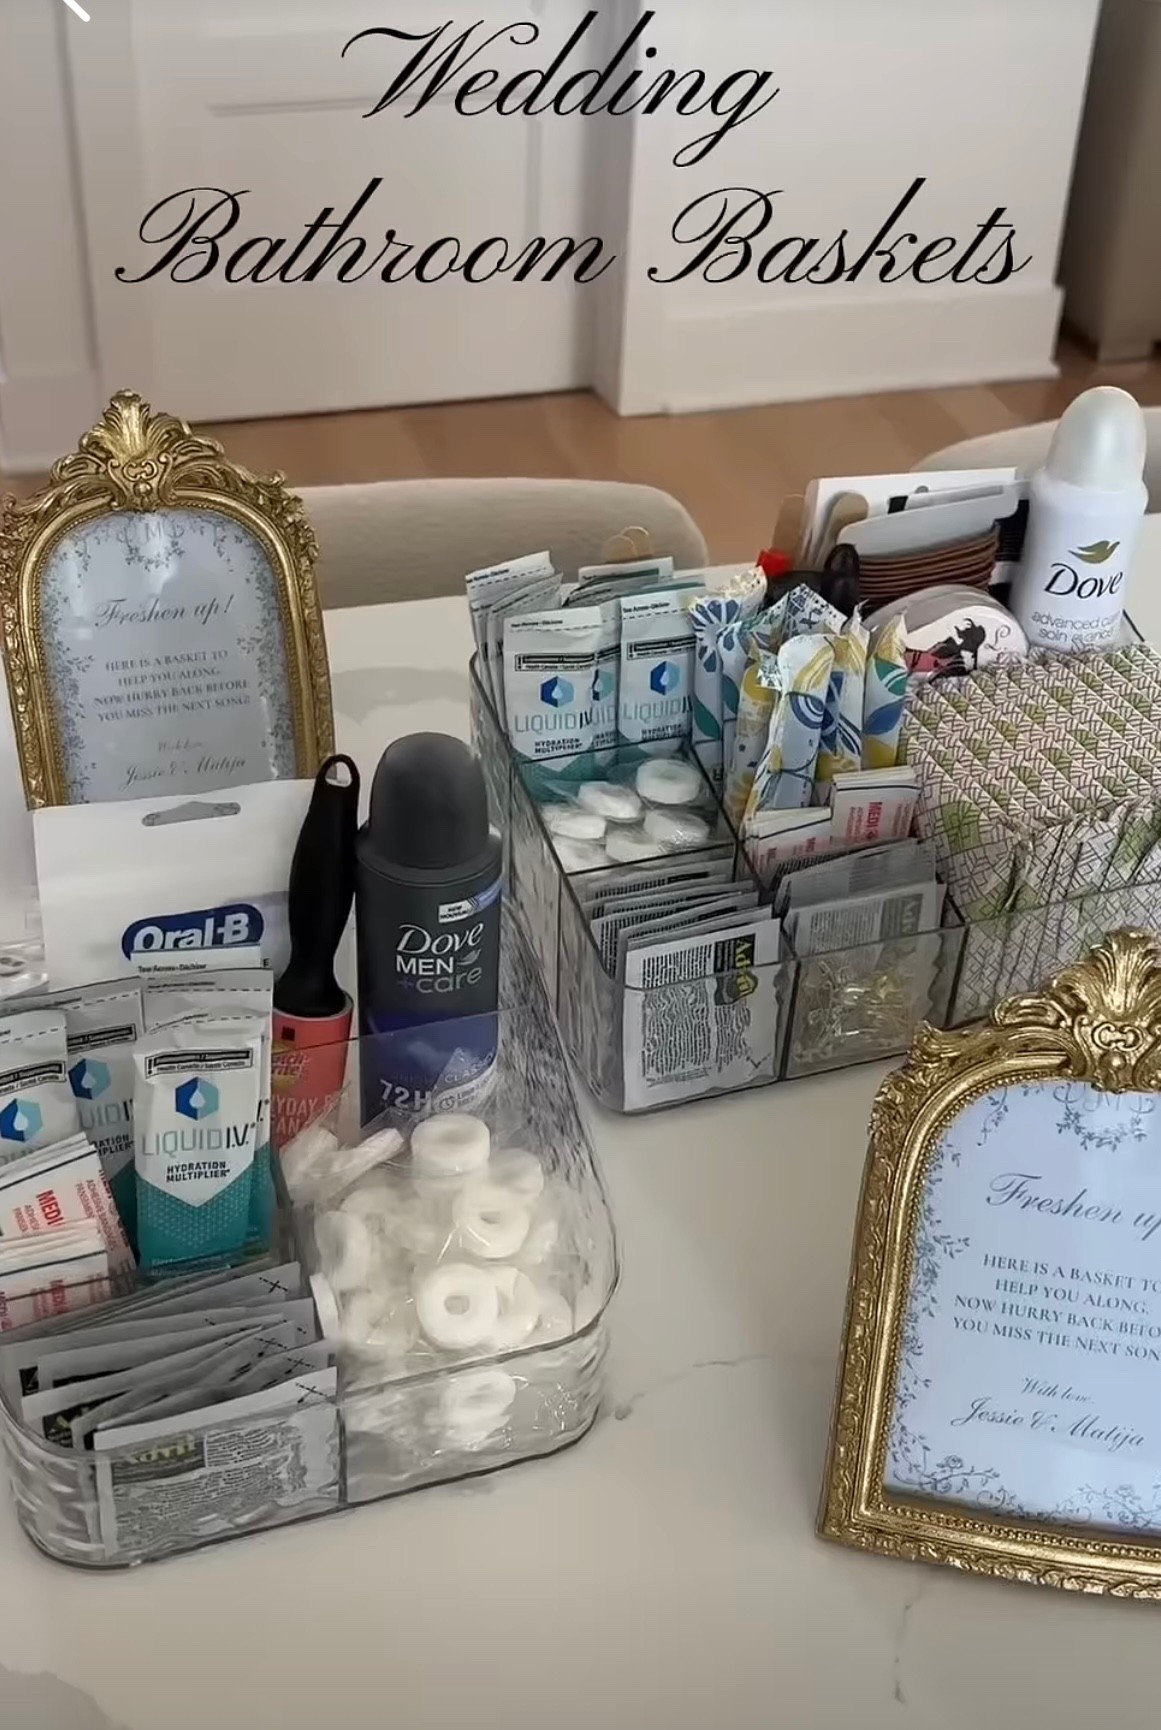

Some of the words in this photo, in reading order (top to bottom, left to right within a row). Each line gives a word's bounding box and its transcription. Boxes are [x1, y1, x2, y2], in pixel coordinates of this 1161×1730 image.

[1044, 562, 1123, 600] Dove
[94, 597, 186, 628] Freshen
[194, 593, 235, 625] up!
[1031, 610, 1100, 631] advanced
[105, 658, 138, 672] HERE
[140, 658, 150, 669] IS
[154, 656, 162, 666] A
[164, 651, 208, 665] BASKET
[211, 650, 228, 661] TO
[118, 674, 148, 687] HELP
[151, 671, 175, 683] YOU
[94, 695, 125, 707] NOW
[126, 689, 168, 703] HURRY
[171, 684, 203, 698] BACK
[206, 679, 249, 694] BEFORE
[98, 709, 125, 722] YOU
[126, 706, 154, 720] MISS
[158, 704, 179, 716] THE
[182, 699, 212, 712] NEXT
[514, 712, 577, 735] LIQUID
[623, 701, 681, 724] LIQUID
[133, 912, 250, 951] Oral-B
[396, 922, 486, 956] Dove
[395, 954, 455, 976] MEN
[142, 1127, 223, 1158] LIQUID
[166, 1168, 230, 1183] MULTIPLIER
[167, 1161, 227, 1174] HYDRATION
[985, 1172, 1122, 1224] Freshen
[983, 1253, 1029, 1273] HERE
[1034, 1261, 1049, 1276] IS
[1052, 1266, 1065, 1279] A
[1070, 1267, 1136, 1290] BASKET
[995, 1278, 1038, 1297] HELP
[1043, 1285, 1080, 1303] YOU
[954, 1294, 998, 1312] NOW
[1001, 1301, 1063, 1324] HURRY
[1066, 1311, 1115, 1332] BACK
[1118, 1320, 1161, 1339] BEFO
[953, 1316, 989, 1334] YOU
[992, 1322, 1032, 1341] MISS
[1037, 1329, 1071, 1348] THE
[1075, 1335, 1122, 1356] NEXT
[1125, 1343, 1161, 1362] SON
[1021, 1376, 1060, 1398] With
[950, 1396, 1025, 1427] Jessie
[1068, 1413, 1145, 1452] Matija
